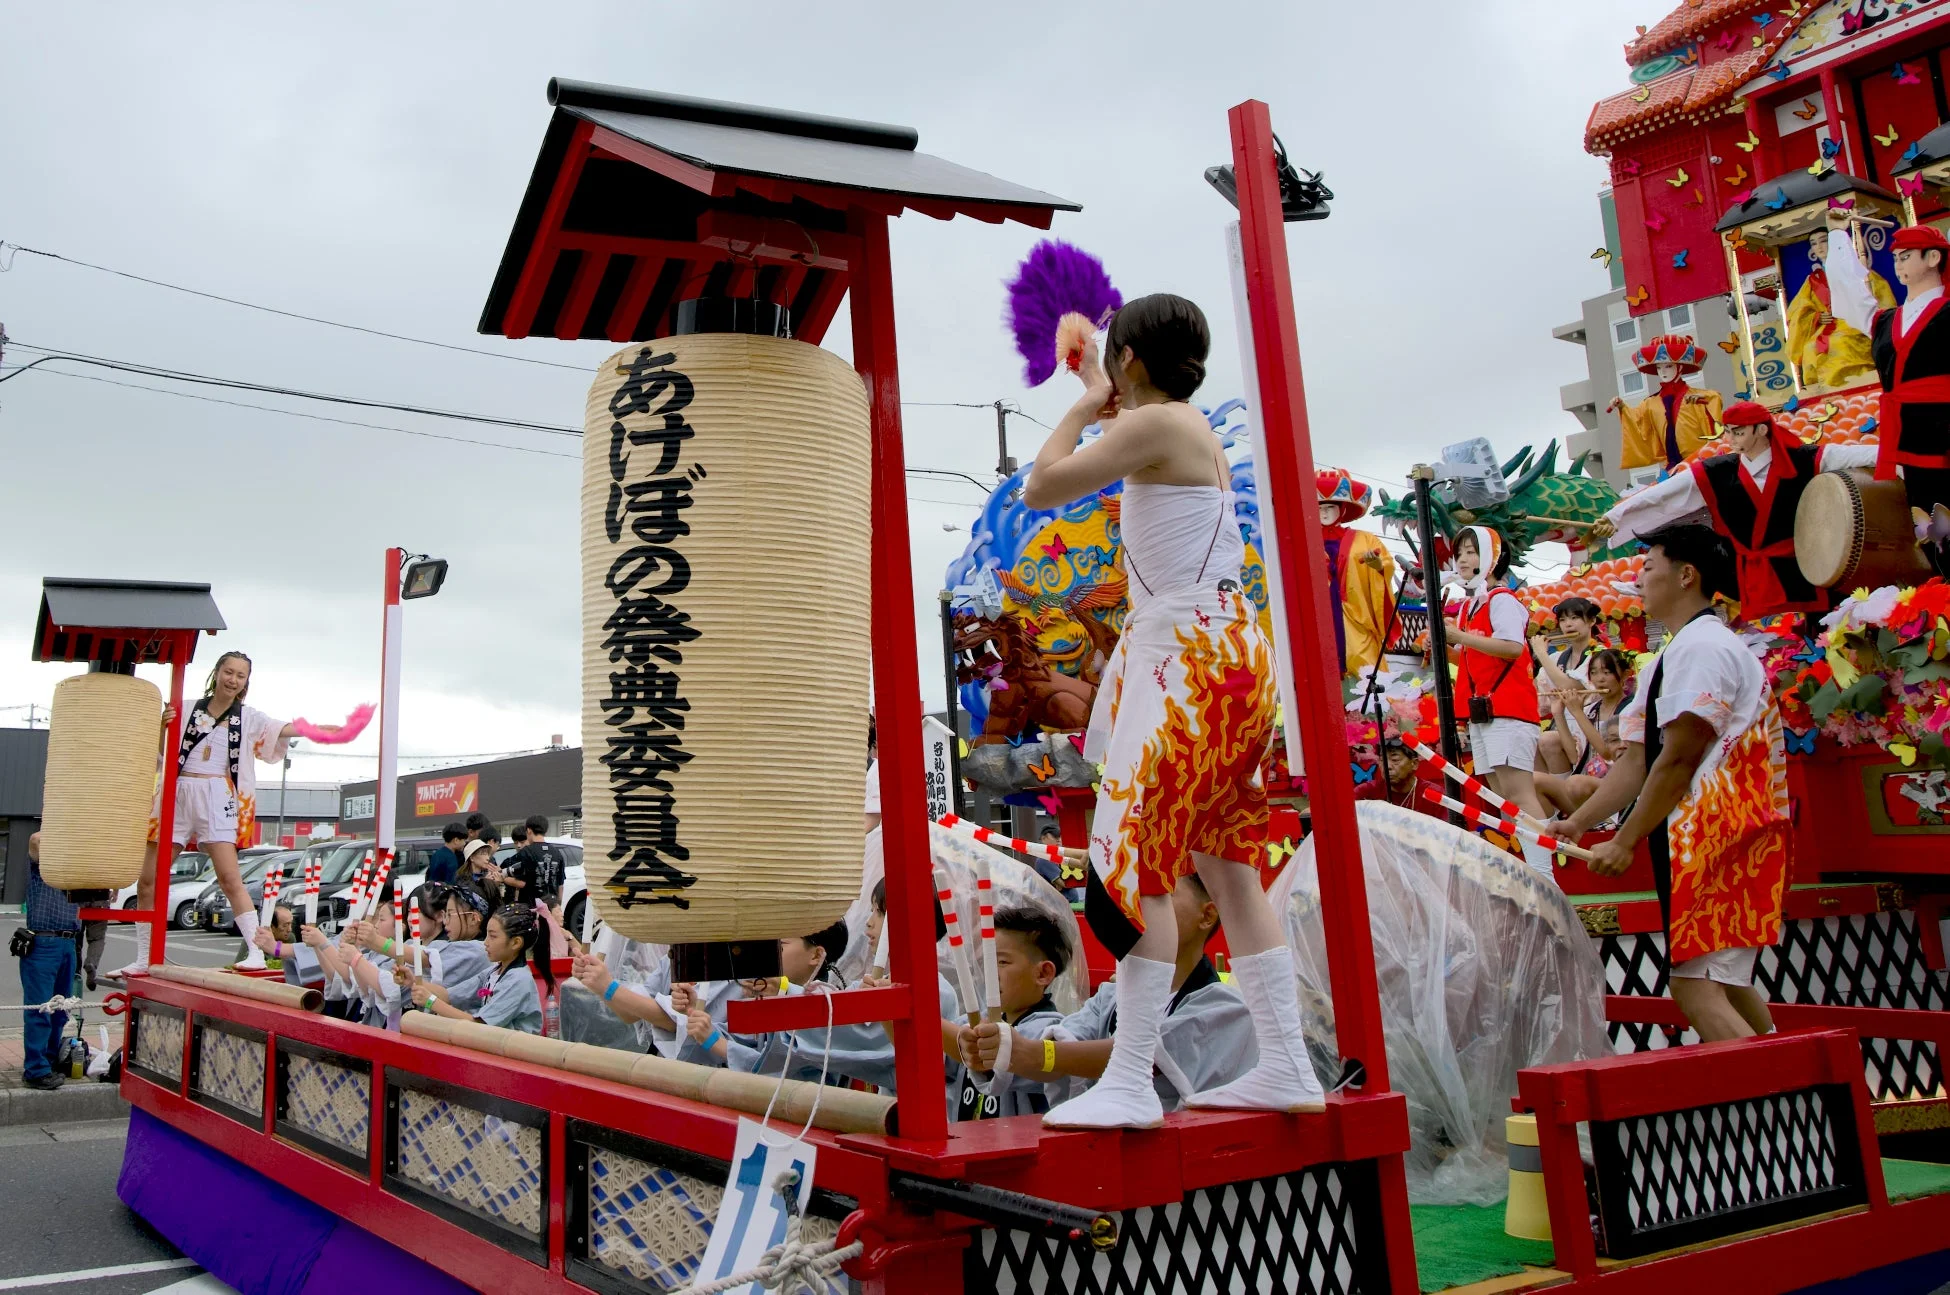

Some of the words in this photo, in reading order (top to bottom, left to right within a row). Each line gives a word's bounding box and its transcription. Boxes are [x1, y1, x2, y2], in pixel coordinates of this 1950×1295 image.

[599, 347, 706, 910] あけぼの祭典委員会
[417, 782, 456, 802] ツルハドラッグ
[934, 741, 947, 820] 守礼の門か
